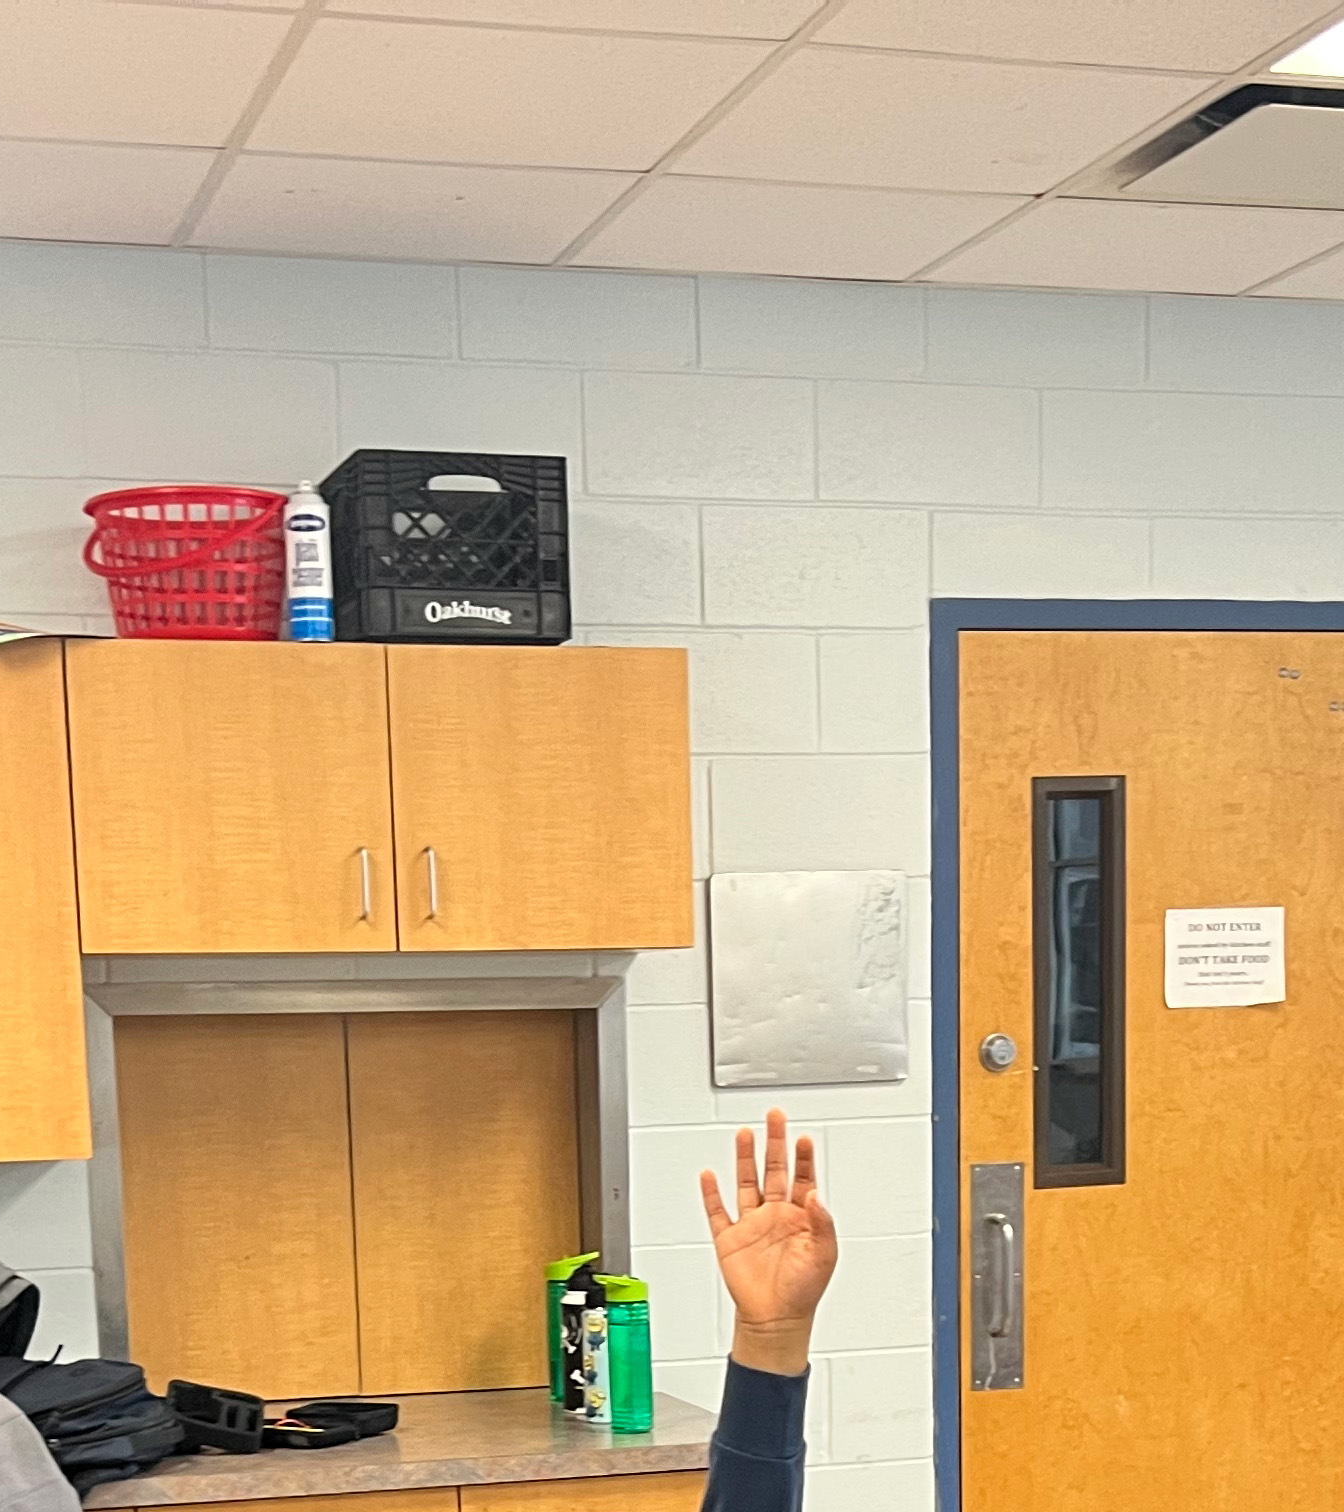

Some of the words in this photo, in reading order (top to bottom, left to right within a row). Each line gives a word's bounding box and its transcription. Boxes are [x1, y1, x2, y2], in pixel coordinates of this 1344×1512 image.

[1187, 923, 1204, 932] DO
[1206, 922, 1227, 932] NOT
[1229, 922, 1262, 932] ENTER
